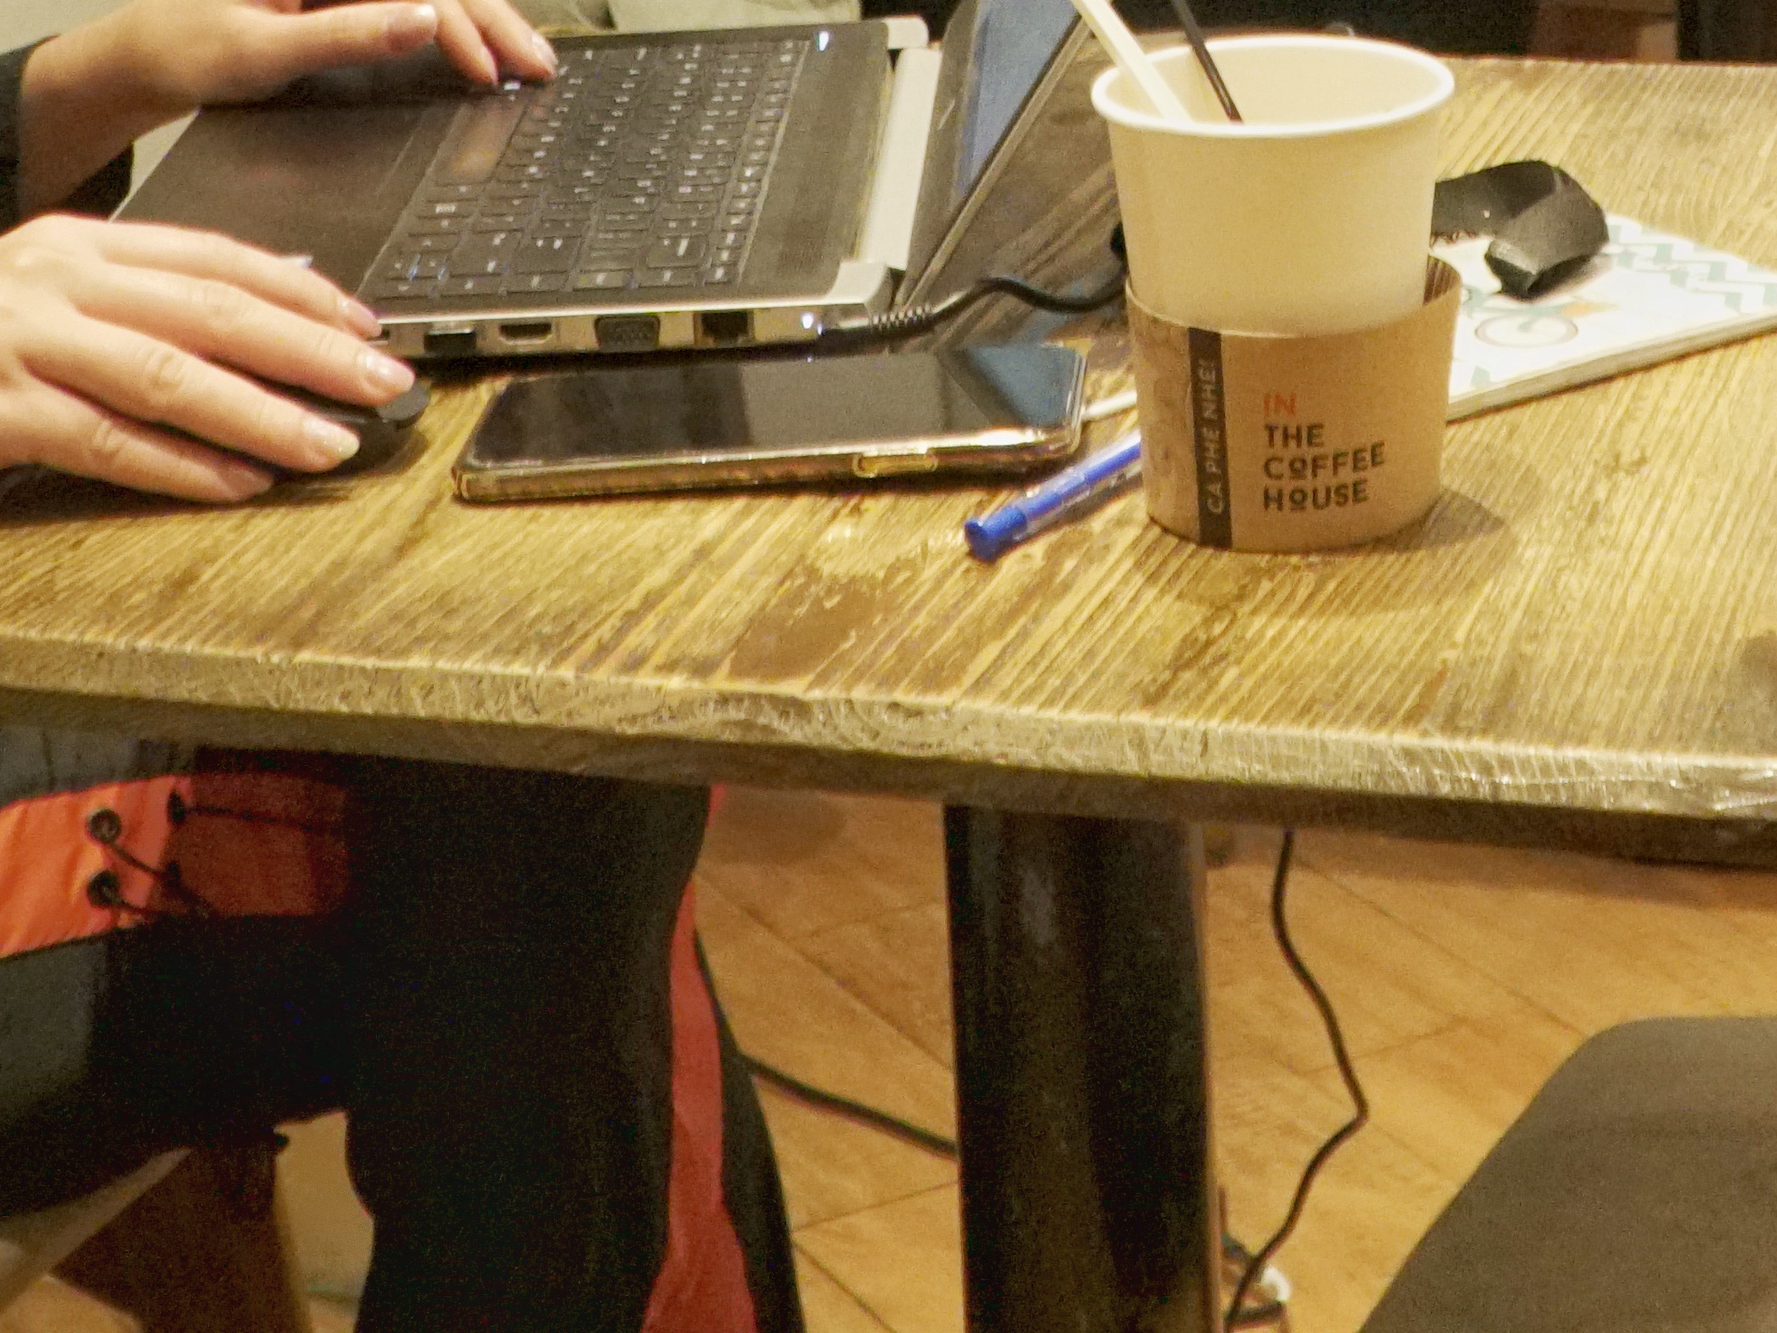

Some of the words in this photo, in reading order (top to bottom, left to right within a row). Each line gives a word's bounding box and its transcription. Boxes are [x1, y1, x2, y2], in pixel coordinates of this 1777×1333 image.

[1263, 392, 1298, 417] IN
[1264, 423, 1325, 449] THE
[1263, 440, 1386, 482] COFFEE
[1263, 480, 1369, 512] HOUSE
